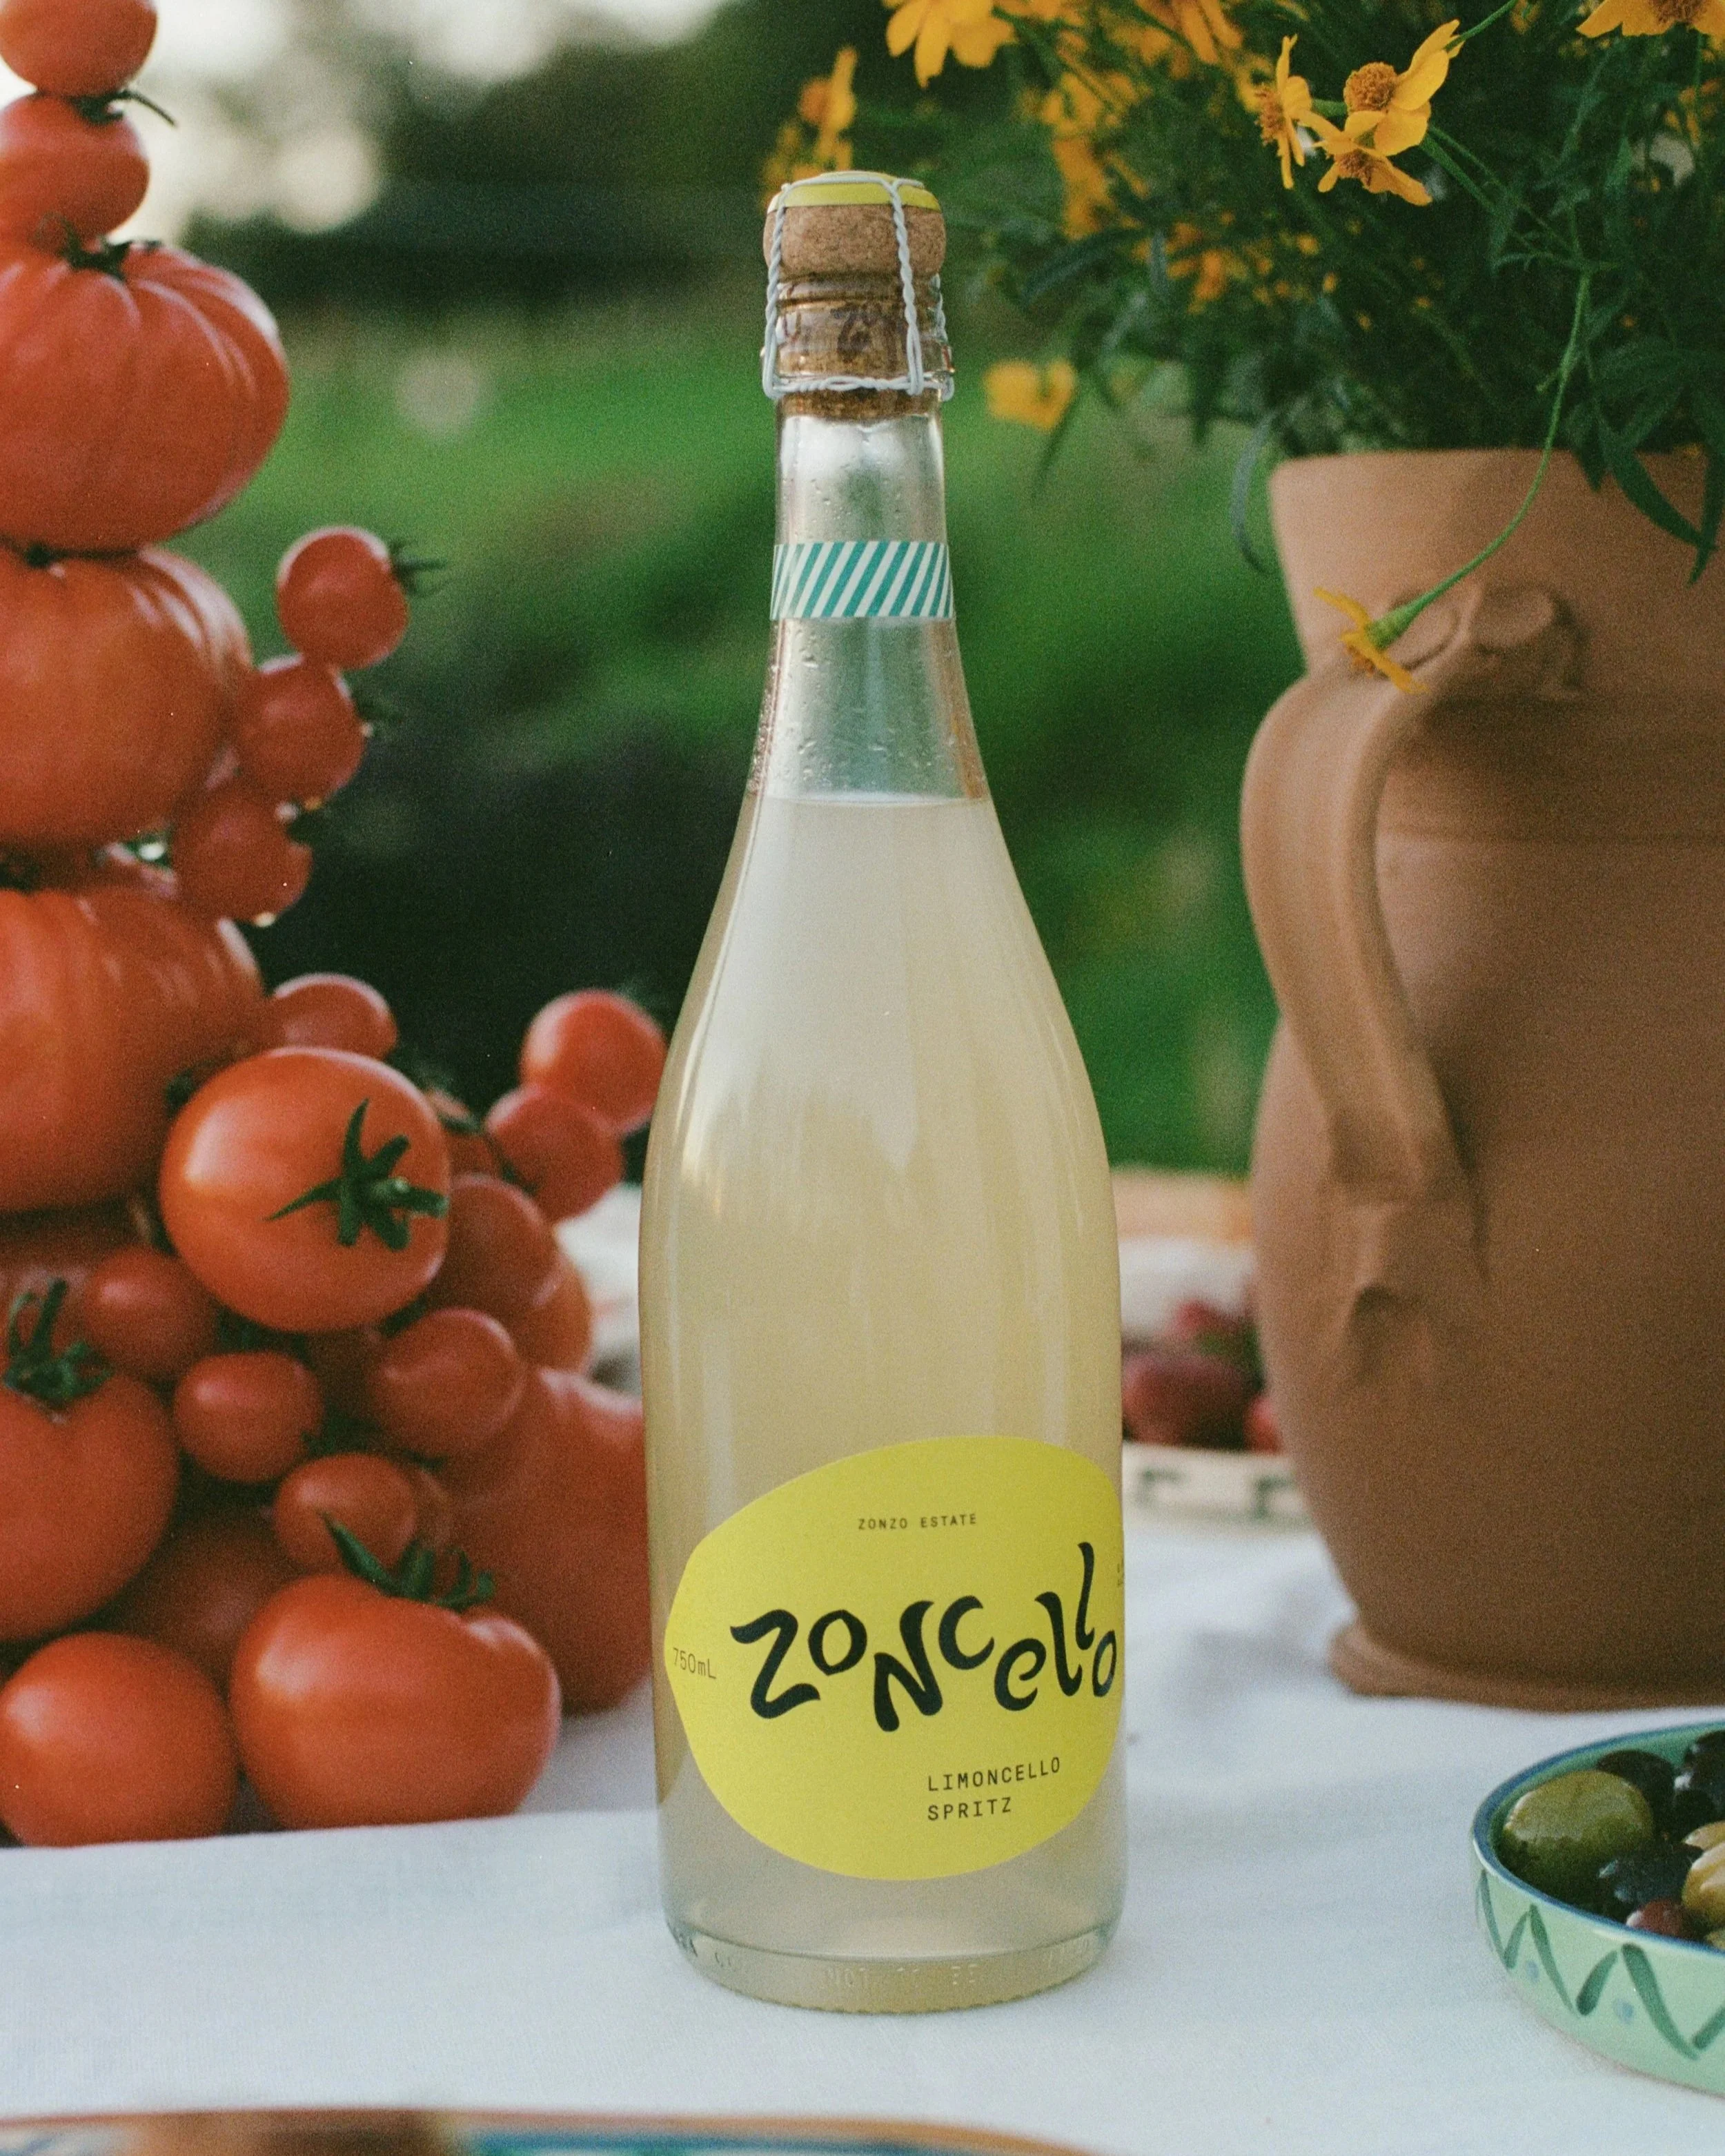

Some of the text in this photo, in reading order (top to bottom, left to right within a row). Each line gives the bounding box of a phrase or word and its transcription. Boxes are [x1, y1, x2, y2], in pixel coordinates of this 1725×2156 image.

[858, 1513, 976, 1530] ZONZO ESTATE
[673, 1647, 717, 1679] 750mL
[927, 1756, 1061, 1792] LIMONCELLO
[927, 1796, 1012, 1821] SPRITZ
